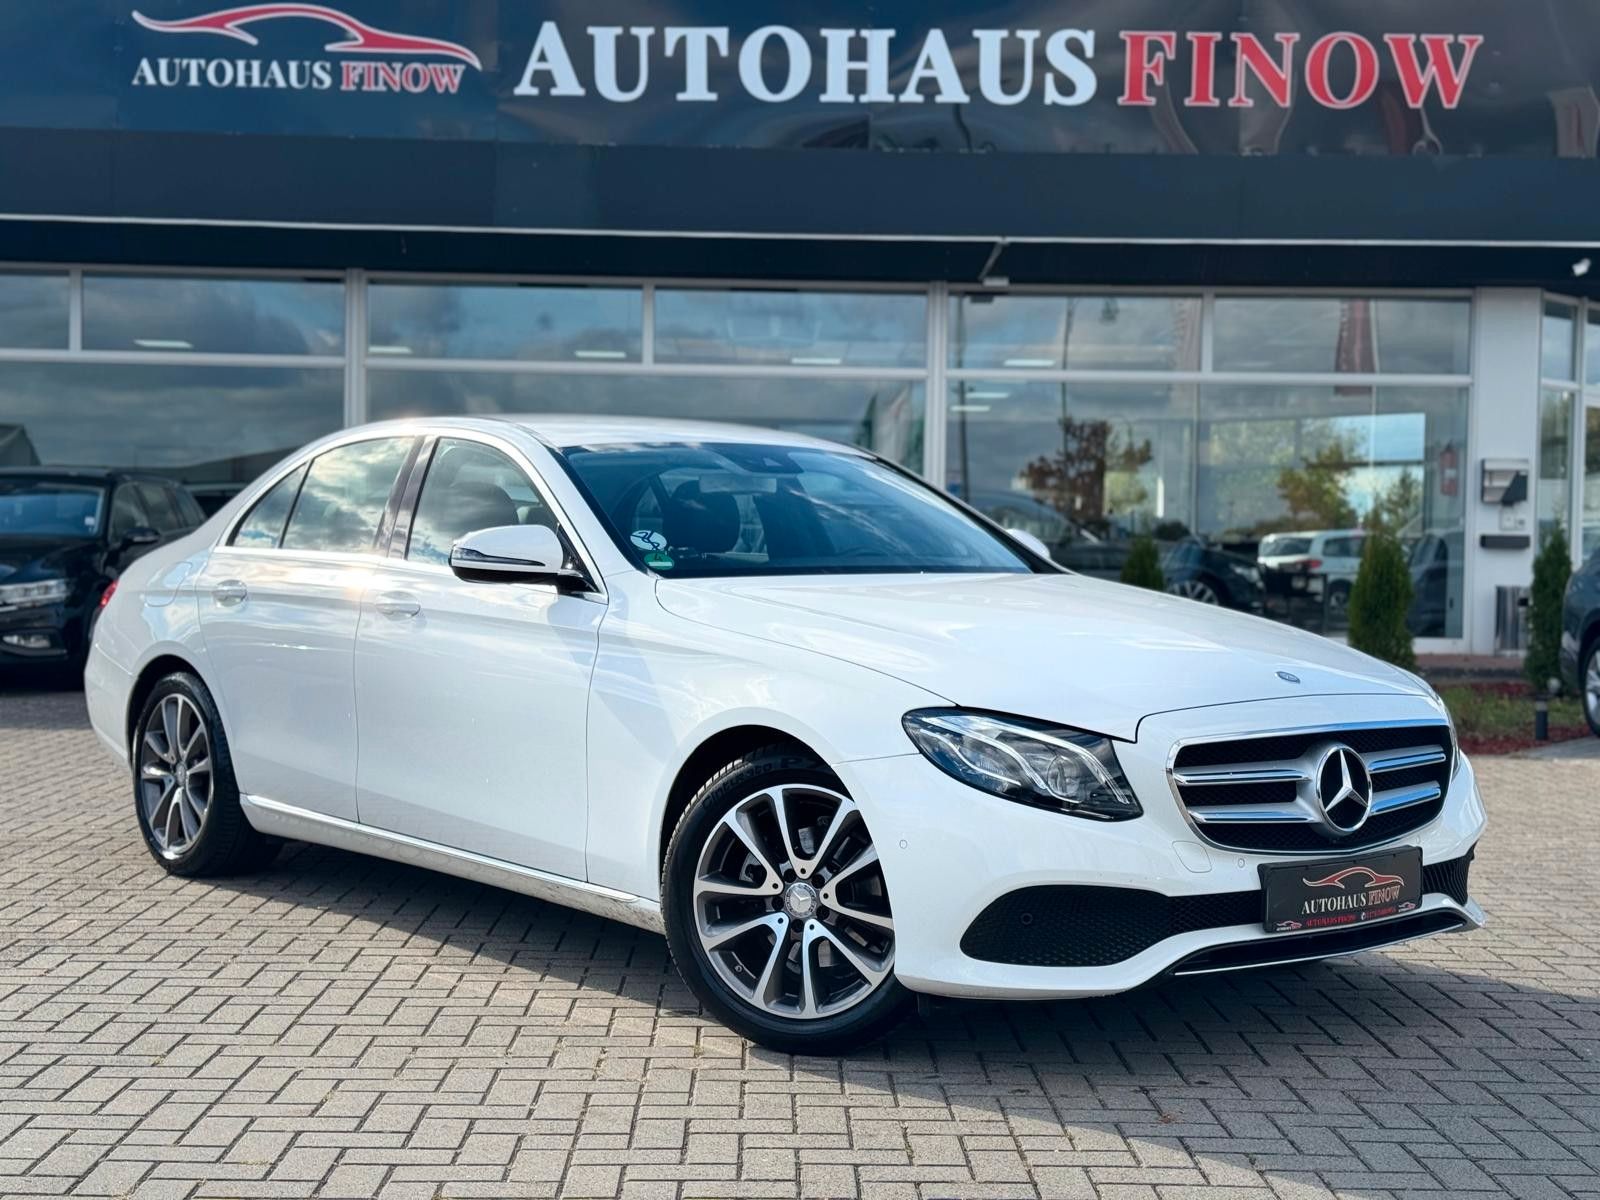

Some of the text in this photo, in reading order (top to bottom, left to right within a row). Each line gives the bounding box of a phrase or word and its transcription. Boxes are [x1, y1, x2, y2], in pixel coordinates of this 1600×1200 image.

[132, 58, 466, 95] AUTOHAUS FINOW
[514, 20, 1485, 110] AUTOHAUS FINOW
[1301, 892, 1367, 915] AUTOHAUS
[1369, 885, 1401, 905] FINOW
